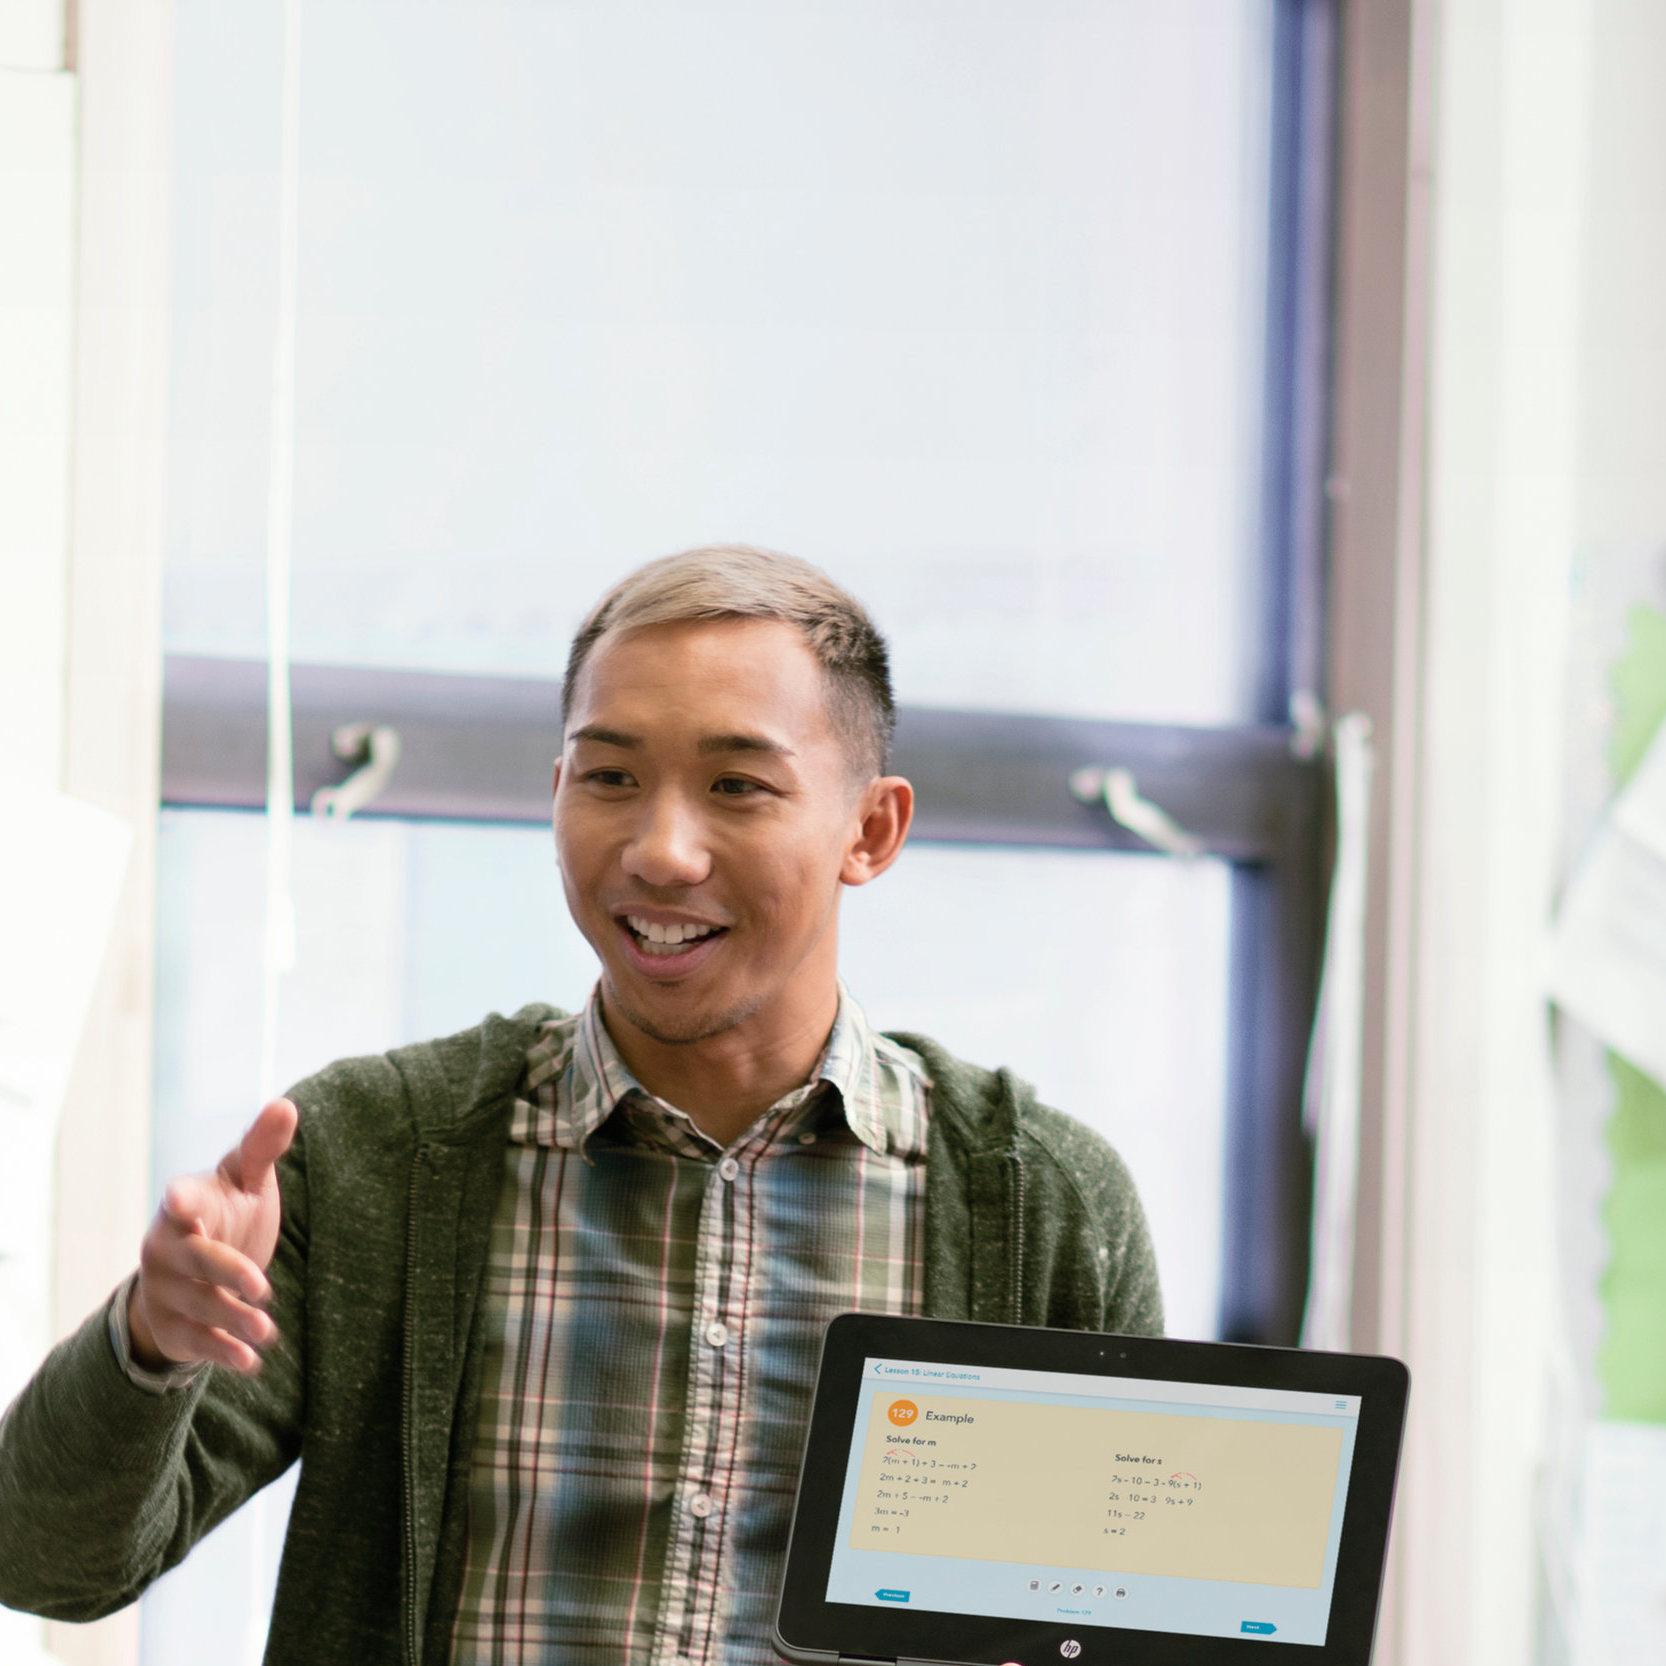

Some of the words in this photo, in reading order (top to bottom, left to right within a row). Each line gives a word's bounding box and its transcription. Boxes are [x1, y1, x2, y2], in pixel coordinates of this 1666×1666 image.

[885, 1367, 909, 1375] Lesson
[923, 1370, 944, 1378] Linear
[946, 1371, 981, 1381] Equations
[892, 1408, 914, 1419] 129
[925, 1410, 975, 1426] Example
[886, 1435, 911, 1445] Solve
[913, 1437, 926, 1446] for
[1115, 1453, 1140, 1464] Solve
[1142, 1456, 1156, 1464] for
[879, 1472, 894, 1481] 2m
[904, 1474, 911, 1484] 2
[961, 1480, 968, 1488] 2
[1132, 1477, 1143, 1486] 10
[876, 1489, 891, 1499] 2m
[942, 1495, 949, 1504] 2
[1109, 1492, 1120, 1501] 2s
[1129, 1494, 1140, 1502] 10
[1108, 1509, 1122, 1518] 11s
[1133, 1511, 1146, 1520] 22
[1061, 1640, 1080, 1658] hp
